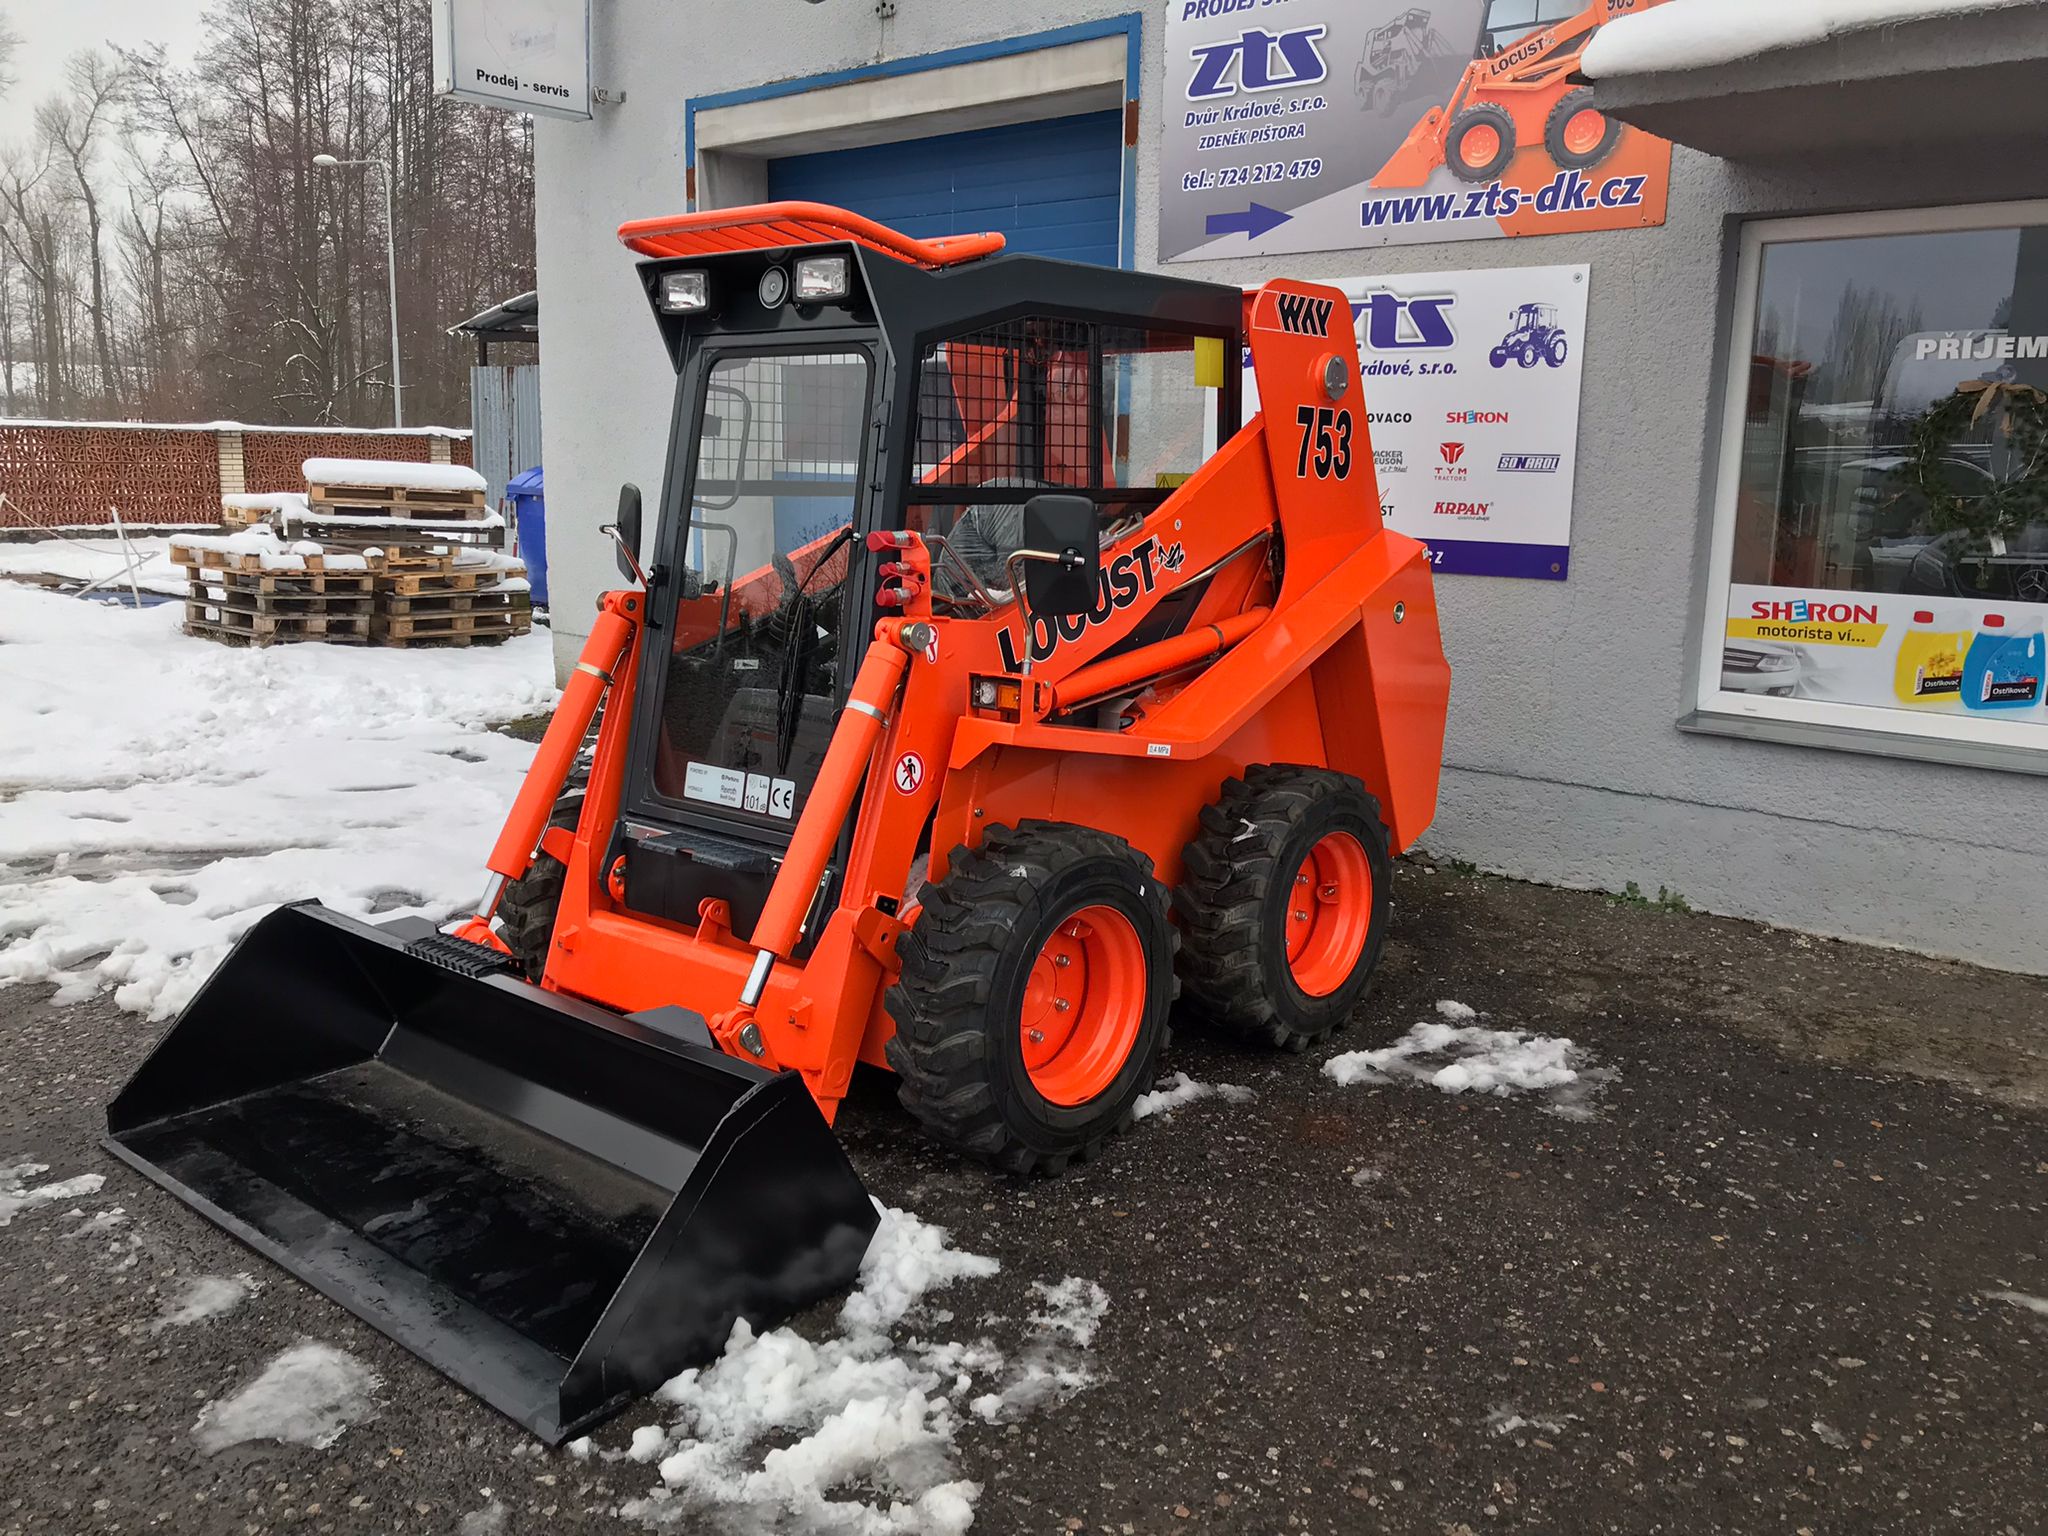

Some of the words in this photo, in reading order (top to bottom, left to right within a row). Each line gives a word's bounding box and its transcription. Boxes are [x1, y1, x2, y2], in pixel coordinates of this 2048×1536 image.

[1188, 29, 1324, 98] zts
[1490, 37, 1546, 76] LOCUST
[476, 68, 519, 91] Prodej
[533, 80, 569, 98] servis
[1184, 107, 1219, 127] Dvůr
[1223, 98, 1284, 122] Králové,
[1289, 96, 1327, 112] s.r.o.
[1198, 129, 1247, 150] ZDENĚK
[1250, 124, 1305, 143] PIŠTORA
[1183, 170, 1214, 190] tel.:
[1219, 167, 1249, 187] 724
[1253, 163, 1284, 182] 212
[1288, 159, 1321, 179] 479
[1361, 170, 1648, 227] www.zts-dk.cz
[1277, 292, 1334, 338] WAY
[1916, 331, 2048, 360] PŘÍJEM
[1360, 359, 1414, 377] rálové,
[1418, 362, 1458, 375] s.r.o.
[1367, 412, 1412, 424] OVACO
[1446, 410, 1508, 424] SHERON
[1296, 405, 1352, 480] 753
[1374, 457, 1403, 465] EUSON
[1433, 501, 1489, 516] KRPAN
[1751, 599, 1878, 624] SHERON
[1757, 625, 1833, 641] motorista
[1837, 629, 1866, 643] ví...
[745, 794, 760, 811] 101
